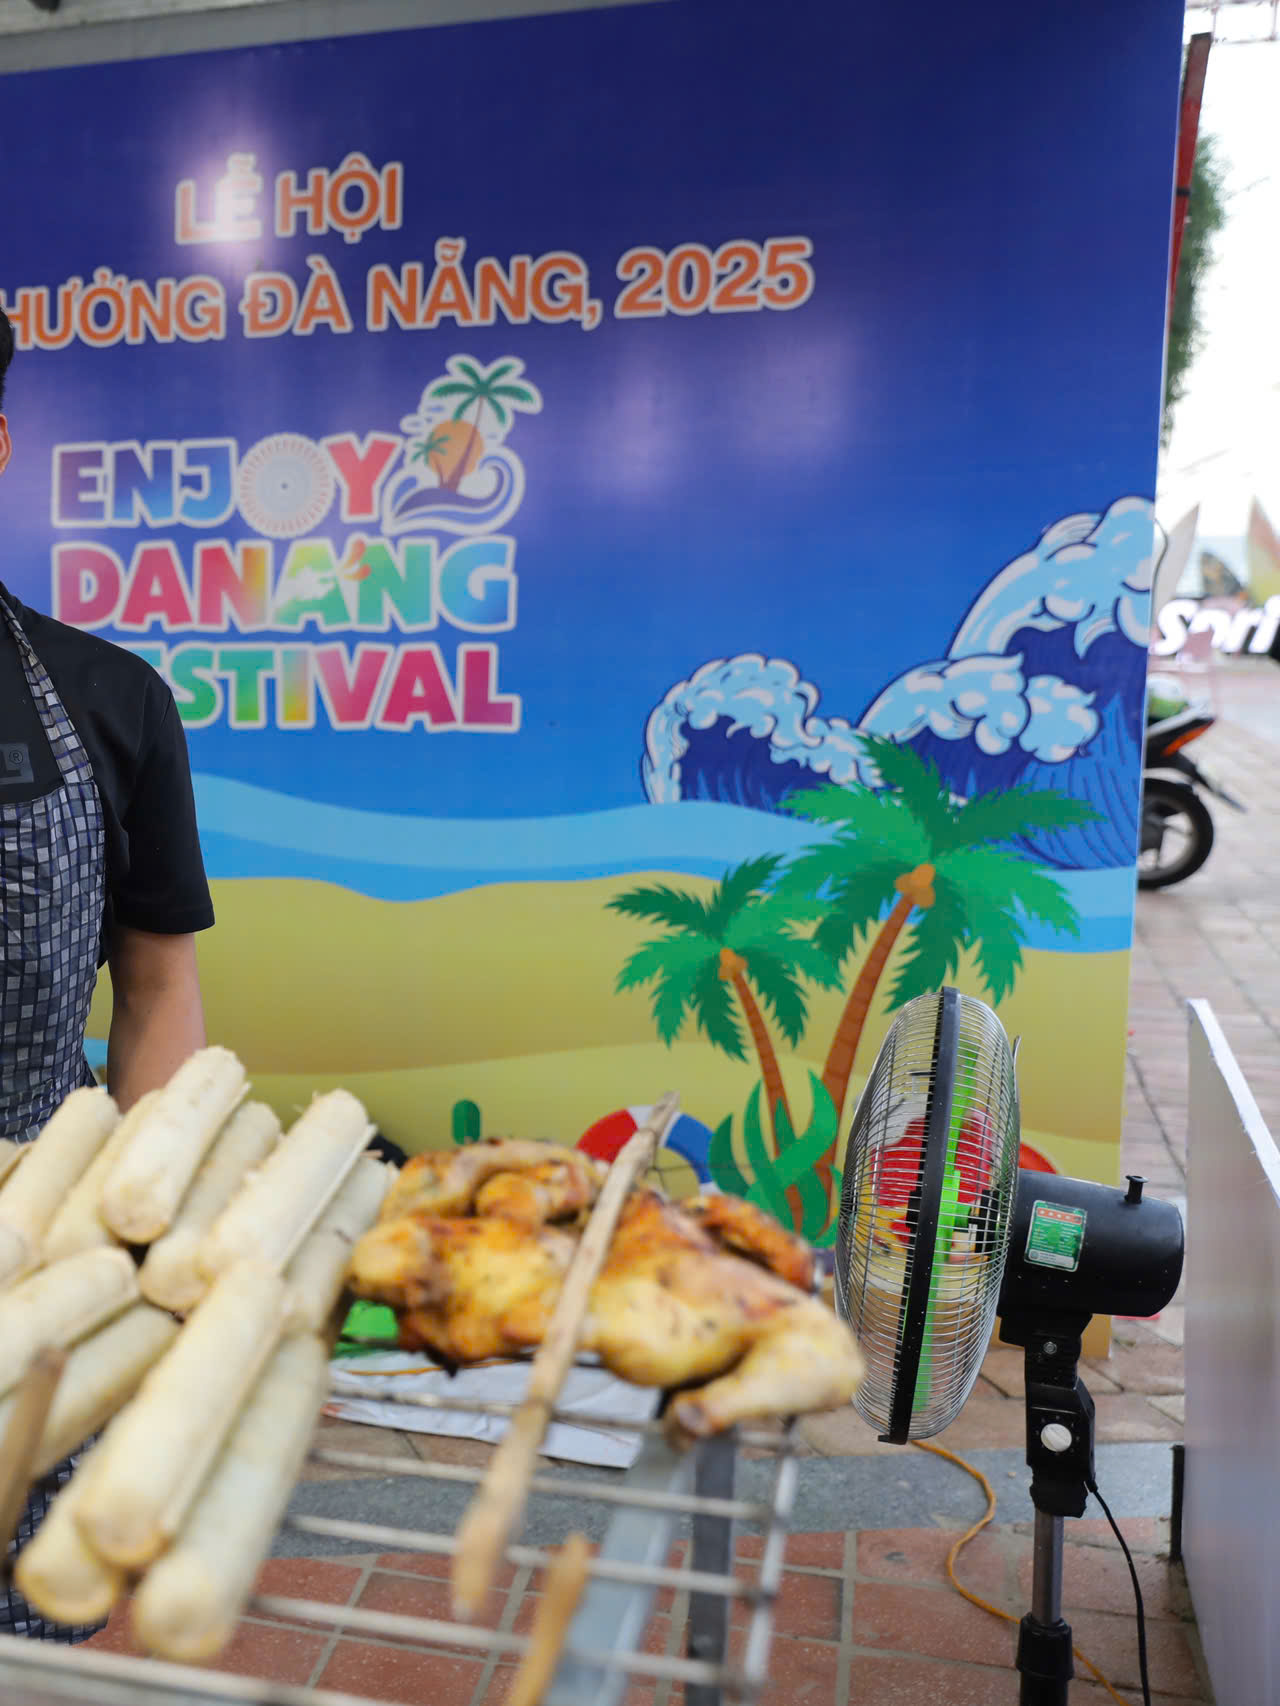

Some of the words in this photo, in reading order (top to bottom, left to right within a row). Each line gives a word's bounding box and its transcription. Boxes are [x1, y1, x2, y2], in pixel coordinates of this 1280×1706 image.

[176, 153, 262, 243] LỄ
[276, 152, 402, 243] HỘI
[239, 254, 353, 338] ĐÀ
[367, 236, 602, 331] NẴNG,
[615, 236, 814, 319] 2025
[51, 431, 403, 538] ENJOY
[51, 533, 518, 633] DANANG
[128, 641, 521, 732] STIVAL
